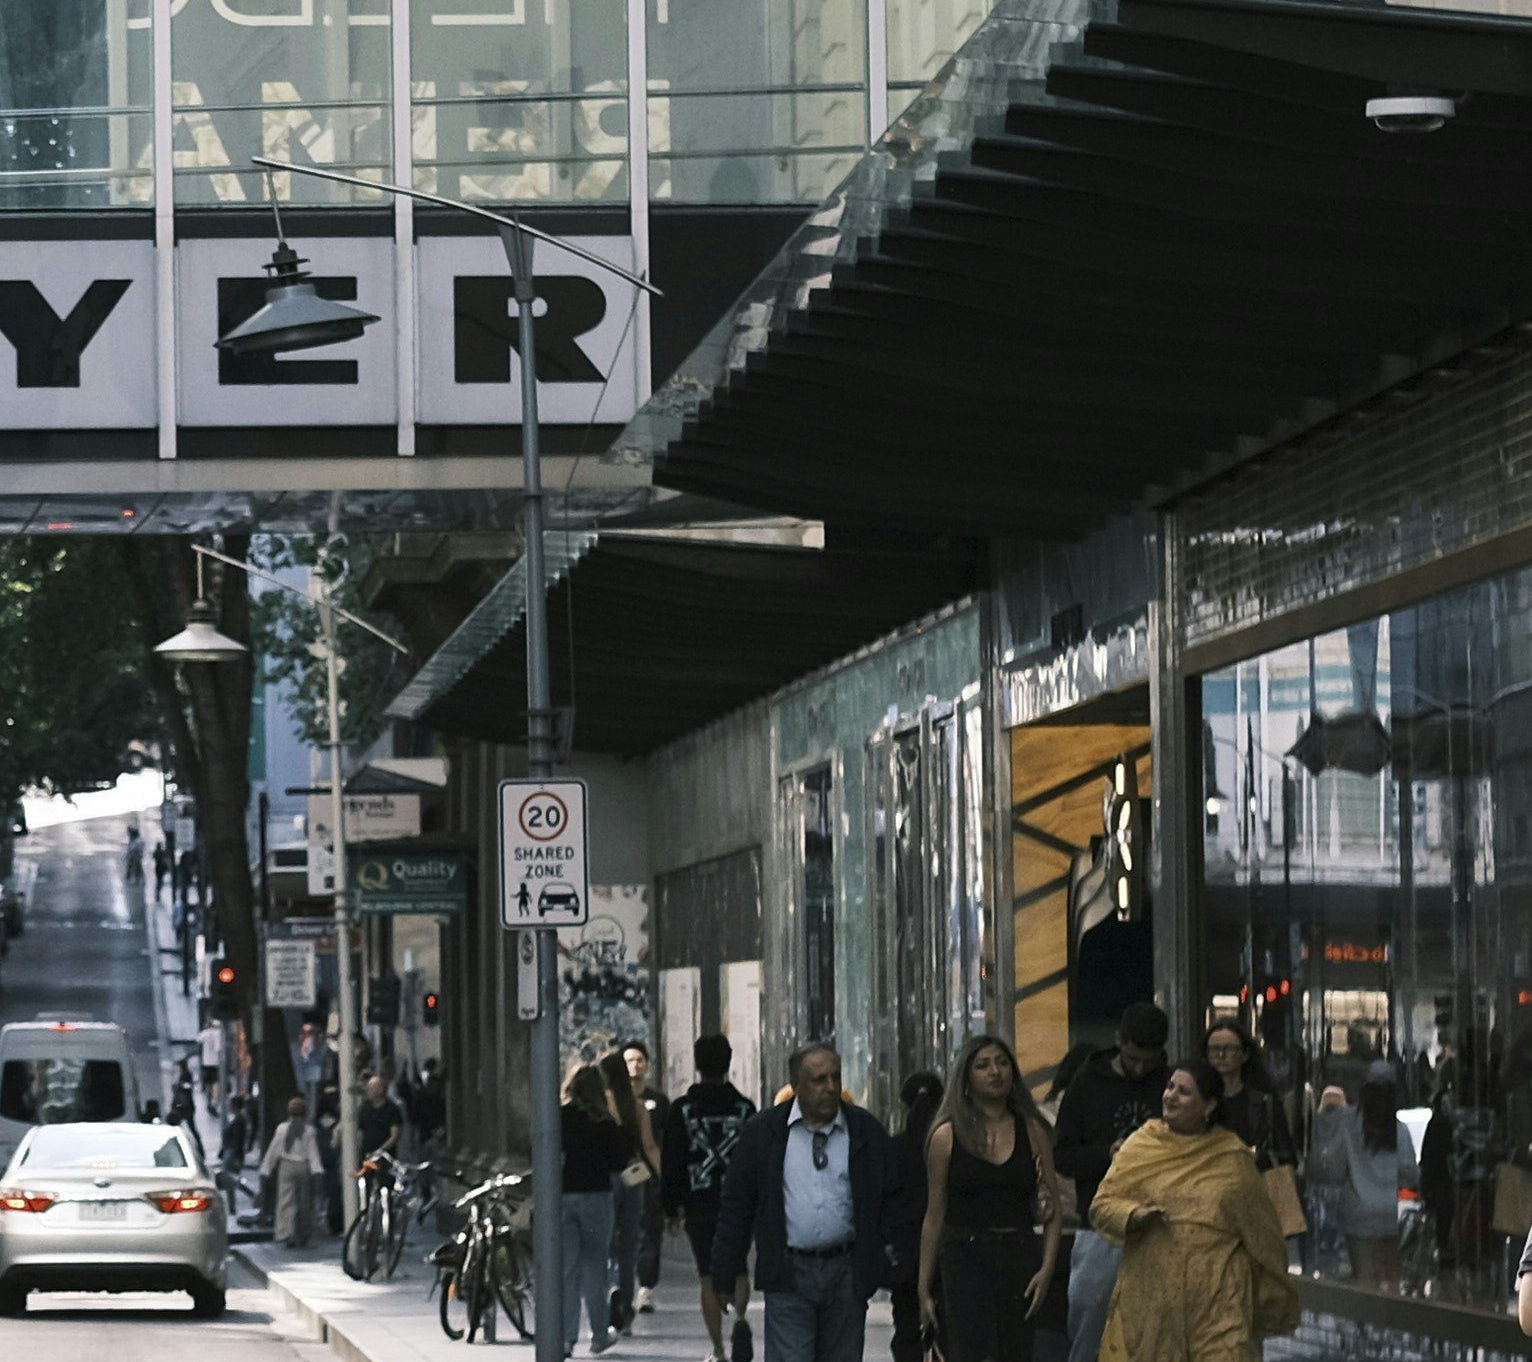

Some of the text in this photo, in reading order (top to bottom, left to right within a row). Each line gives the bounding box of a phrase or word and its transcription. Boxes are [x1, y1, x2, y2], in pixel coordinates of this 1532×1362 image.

[528, 805, 560, 828] 20
[514, 846, 575, 861] SHARED
[393, 859, 458, 881] Quality
[525, 864, 564, 879] ZONE
